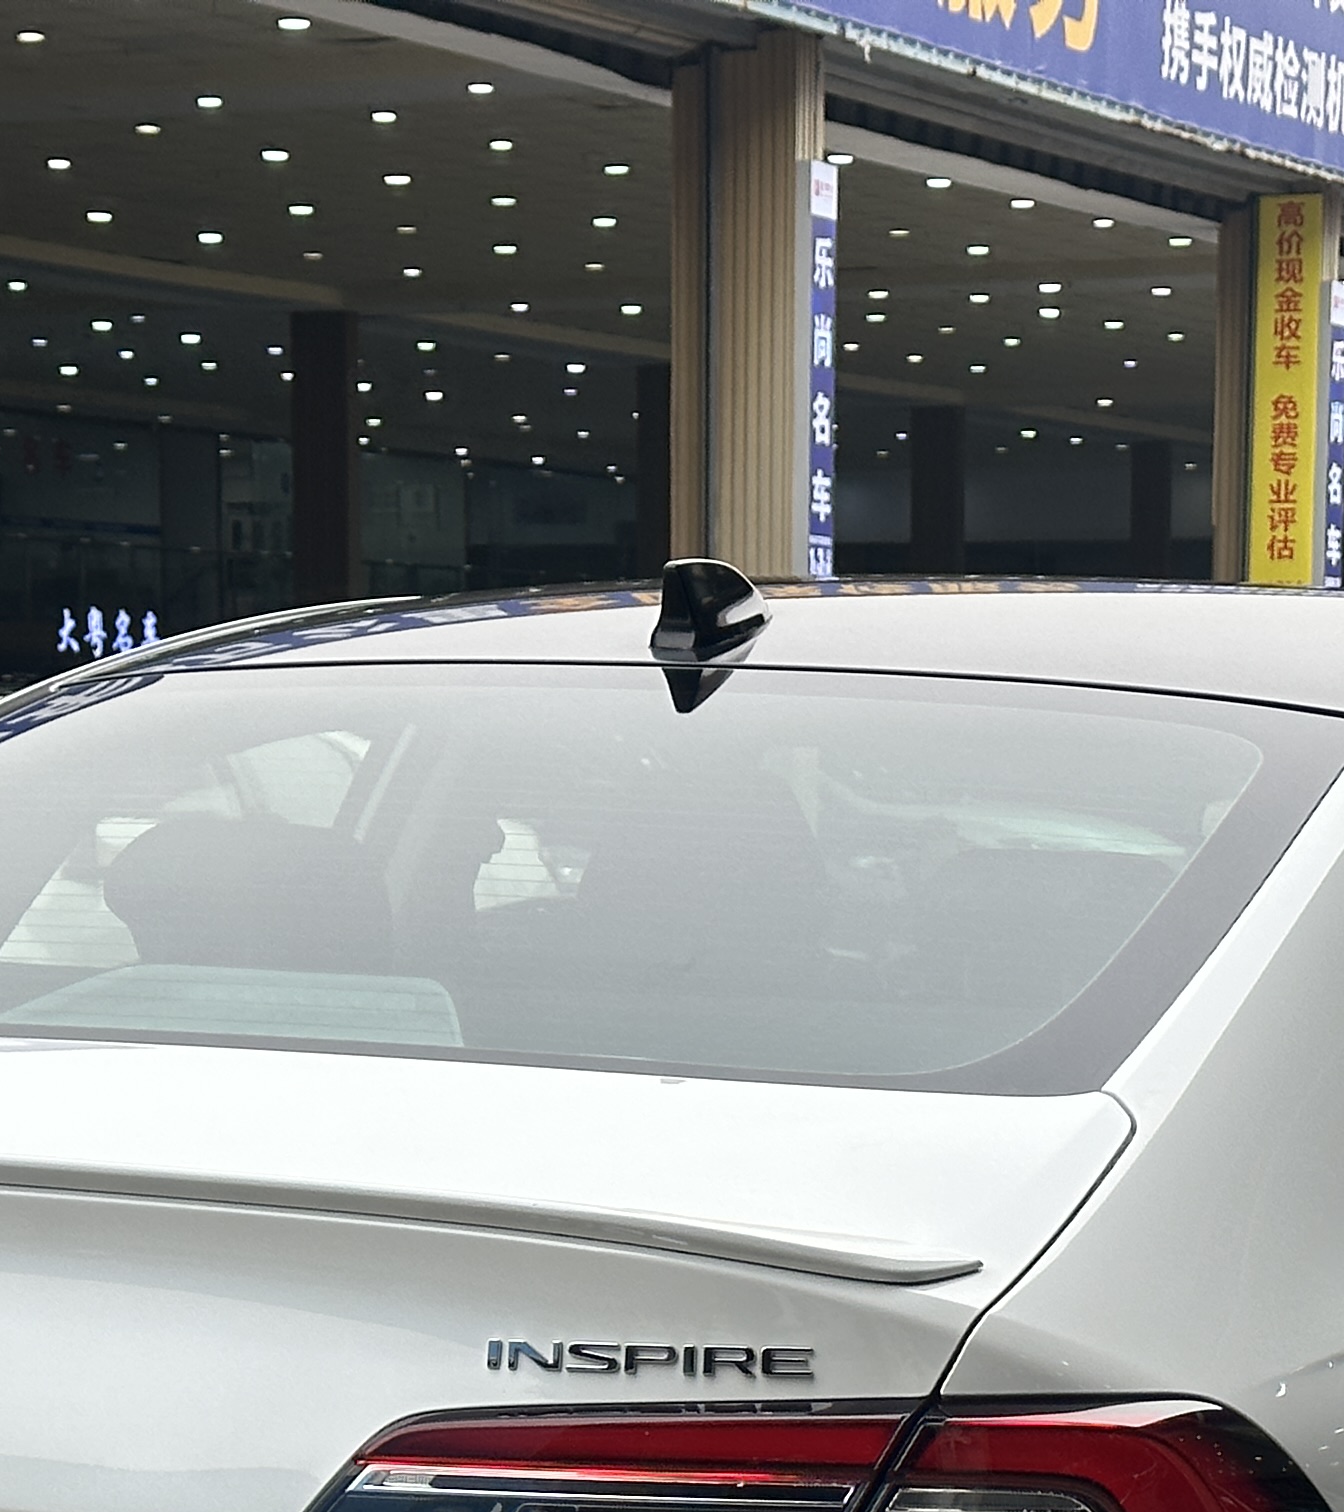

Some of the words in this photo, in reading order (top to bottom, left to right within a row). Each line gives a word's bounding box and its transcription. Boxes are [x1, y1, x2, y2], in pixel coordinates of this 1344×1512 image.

[1272, 201, 1304, 371] 高价现金收车
[811, 237, 835, 522] 乐尚名车
[1266, 393, 1300, 560] 免费专业评估
[487, 1338, 814, 1377] INSPIRE
